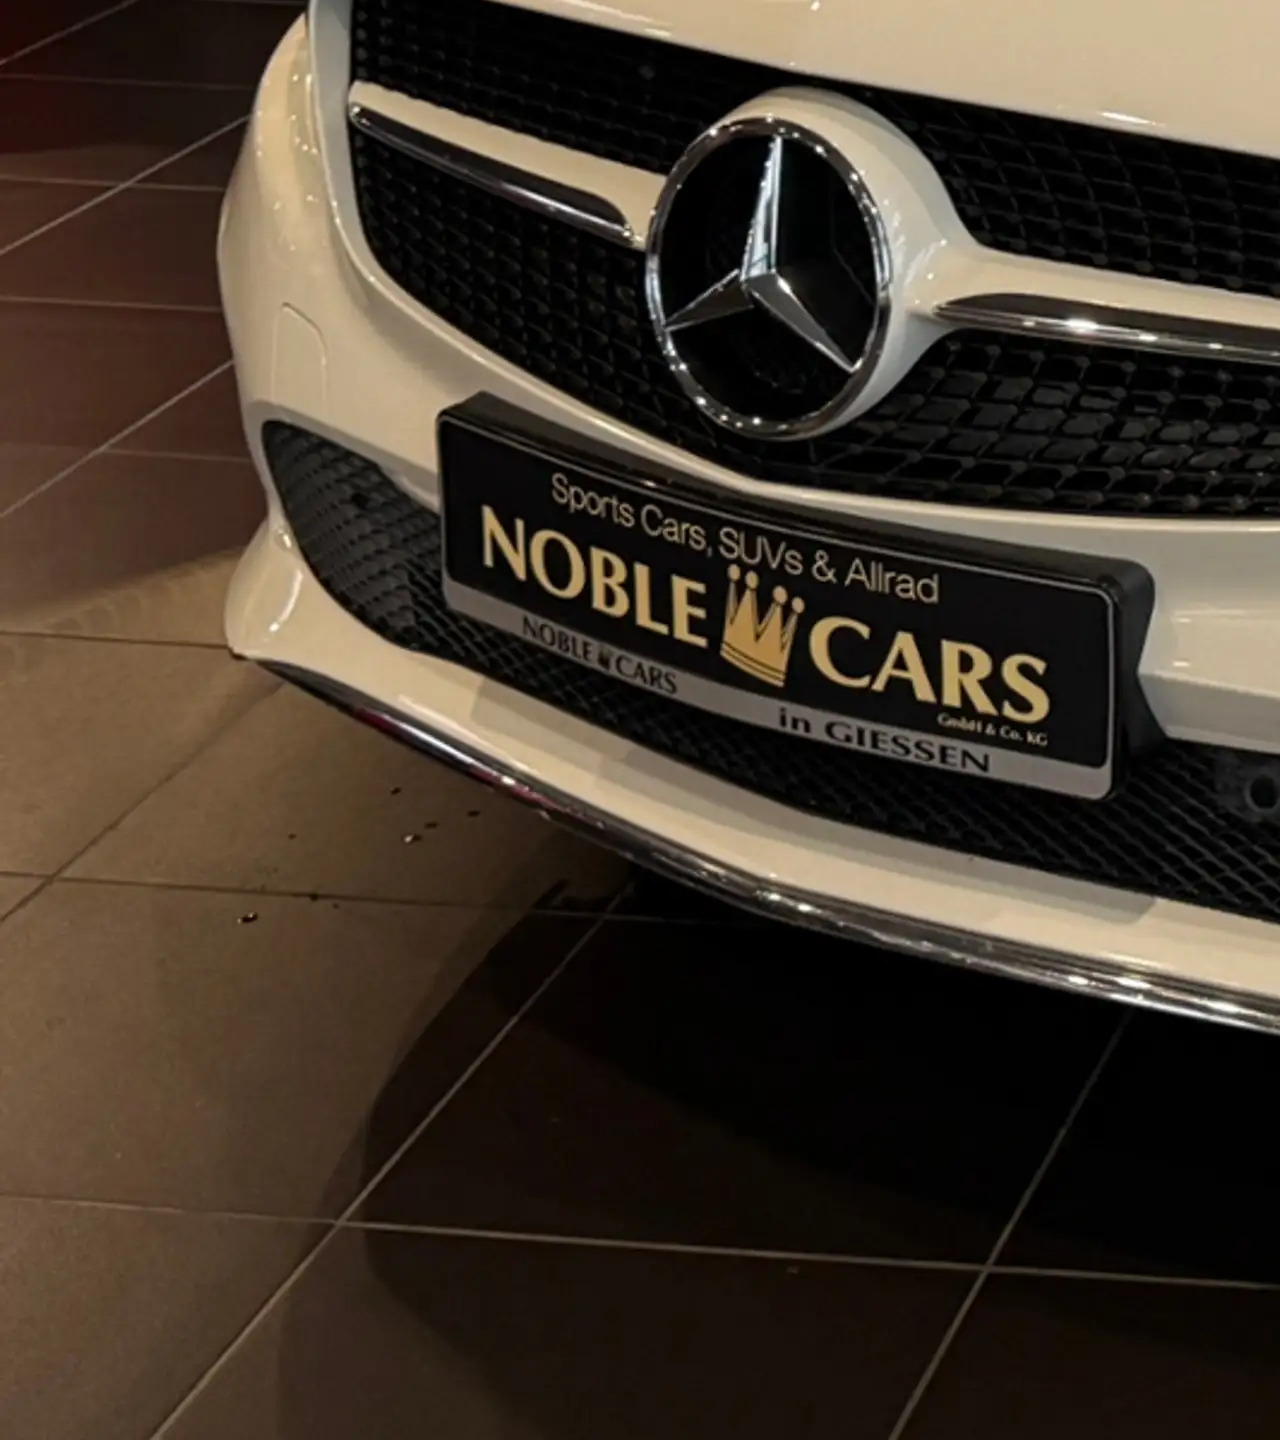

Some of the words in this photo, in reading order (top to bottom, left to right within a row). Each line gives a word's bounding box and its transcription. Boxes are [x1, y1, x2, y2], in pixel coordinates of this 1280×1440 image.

[552, 472, 635, 529] Sports
[639, 504, 713, 557] Cars,
[718, 526, 804, 576] SUVs
[811, 549, 837, 585] &
[844, 557, 940, 605] Allrad
[481, 503, 708, 649] NOBLE
[808, 615, 1050, 725] CARS
[522, 615, 593, 663] NOBLE
[615, 654, 678, 694] CARS
[778, 707, 812, 734] in
[824, 720, 990, 773] GIESSEN
